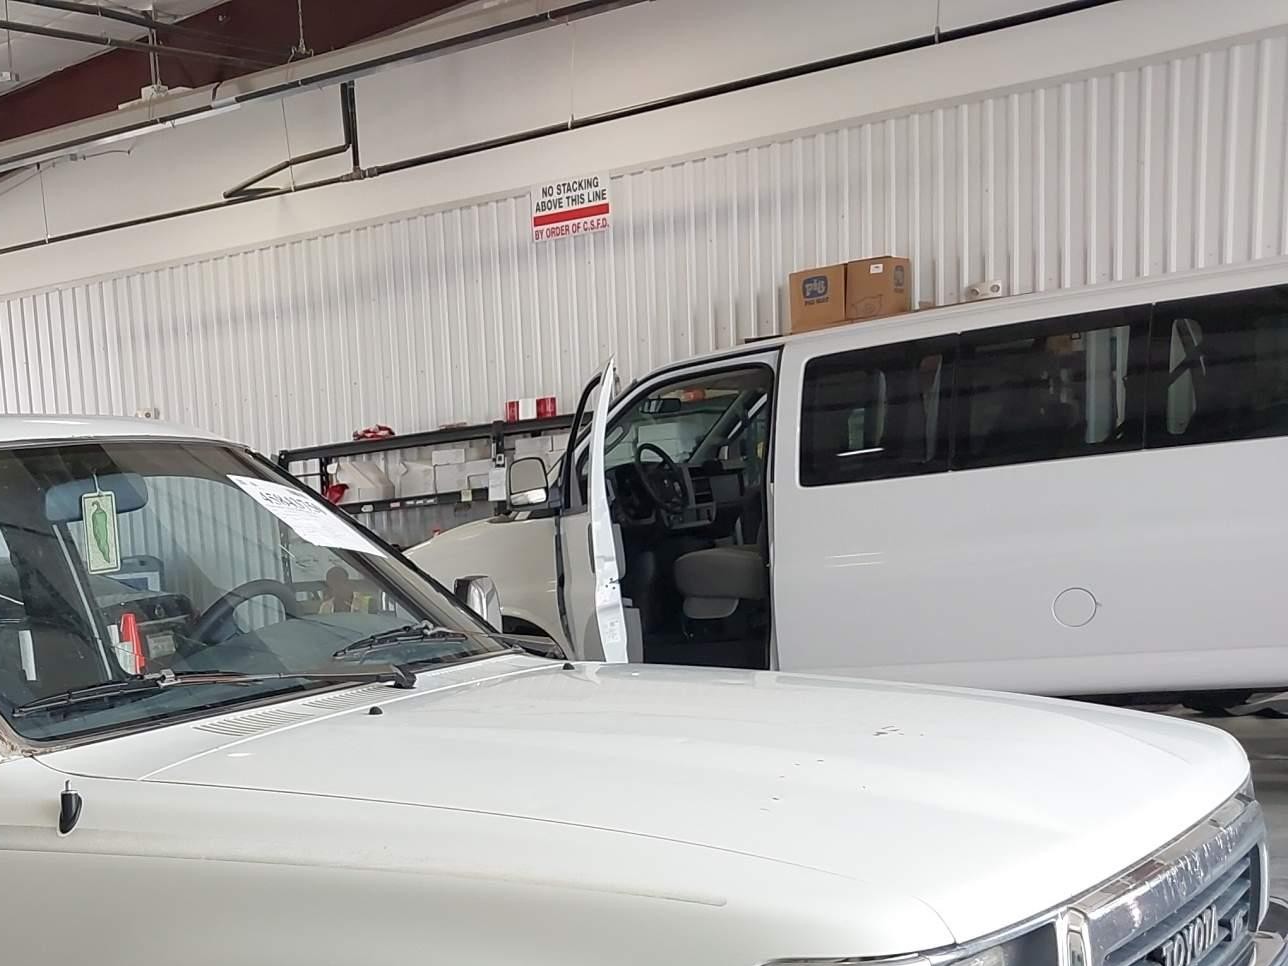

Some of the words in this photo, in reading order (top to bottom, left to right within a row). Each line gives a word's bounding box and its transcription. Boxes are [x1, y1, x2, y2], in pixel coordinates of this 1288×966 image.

[541, 185, 554, 199] NO
[556, 176, 600, 195] STACKING
[535, 196, 563, 213] ABOVE
[565, 193, 585, 208] THIS
[587, 188, 607, 204] LINE
[534, 229, 544, 241] BY
[546, 224, 570, 238] ORDER
[572, 221, 581, 233] OF
[583, 218, 610, 232] C.S.F.D.
